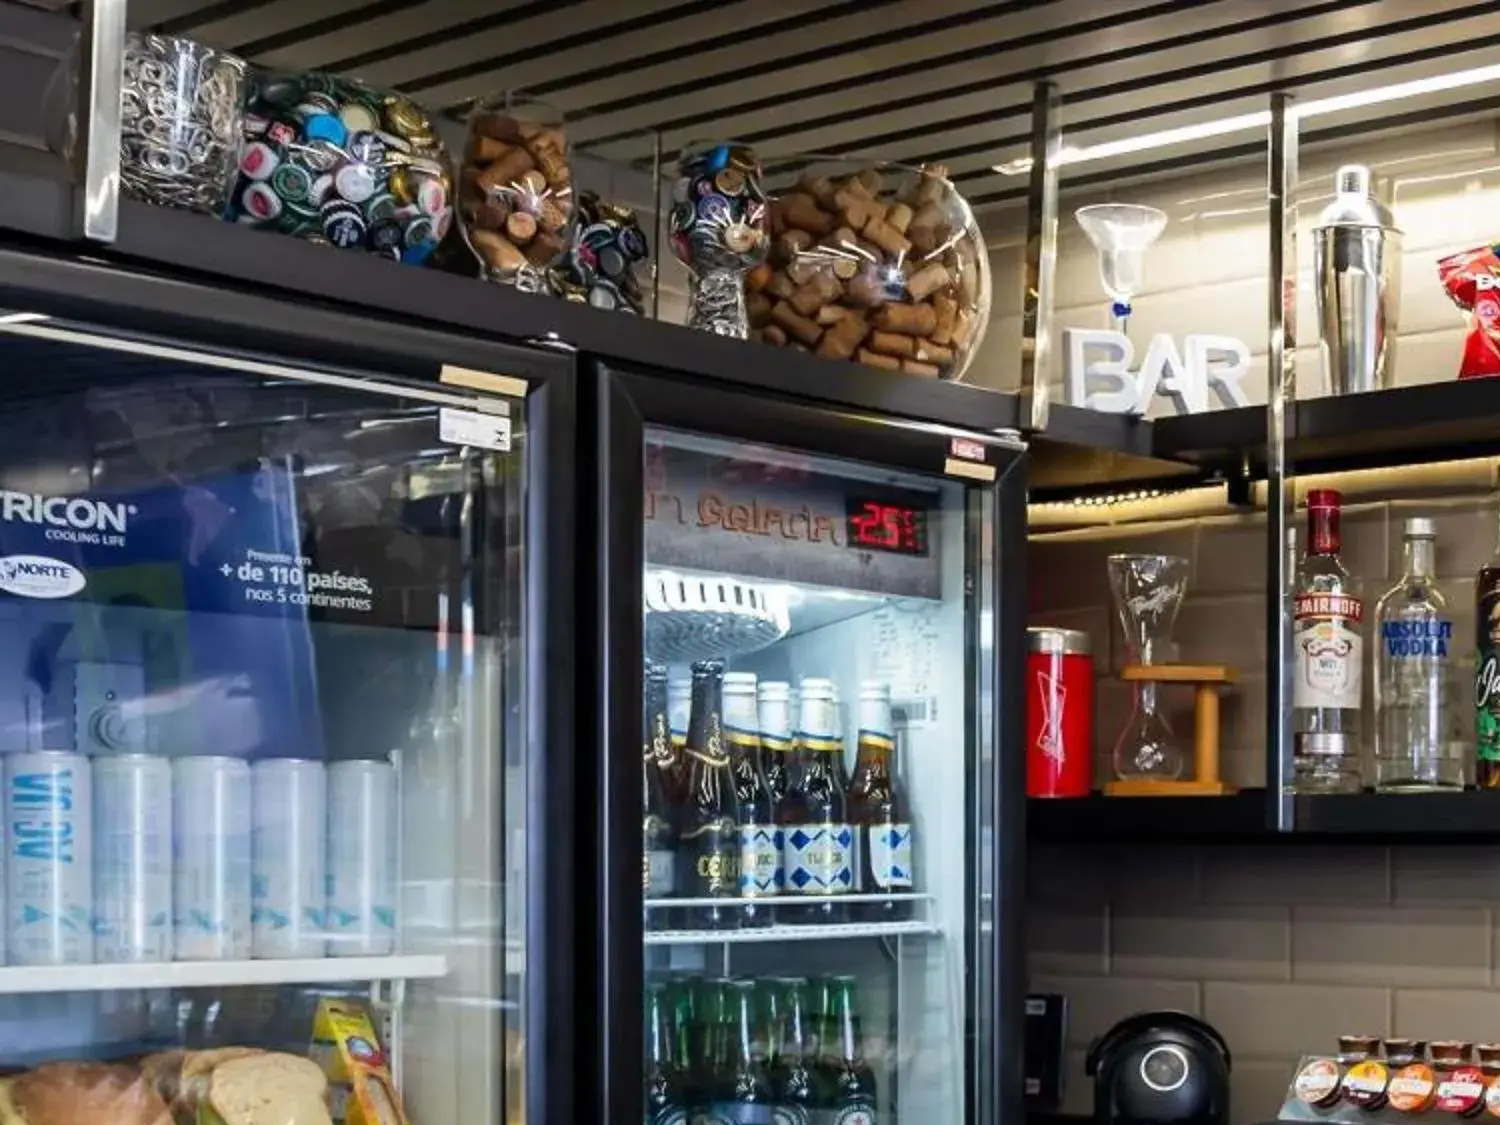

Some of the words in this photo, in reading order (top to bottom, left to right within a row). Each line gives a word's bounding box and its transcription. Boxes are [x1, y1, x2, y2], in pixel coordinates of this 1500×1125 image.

[1064, 328, 1252, 415] BAR
[45, 529, 98, 543] COOLING
[103, 534, 125, 546] LIFE
[18, 563, 71, 580] NORTE
[238, 566, 264, 583] de
[269, 566, 301, 586] 110
[308, 572, 373, 595] países,
[246, 586, 273, 602] nos
[278, 588, 286, 602] 5
[289, 591, 372, 611] continentes
[1382, 621, 1452, 638] ABSOLUT
[1387, 639, 1447, 657] VODKA
